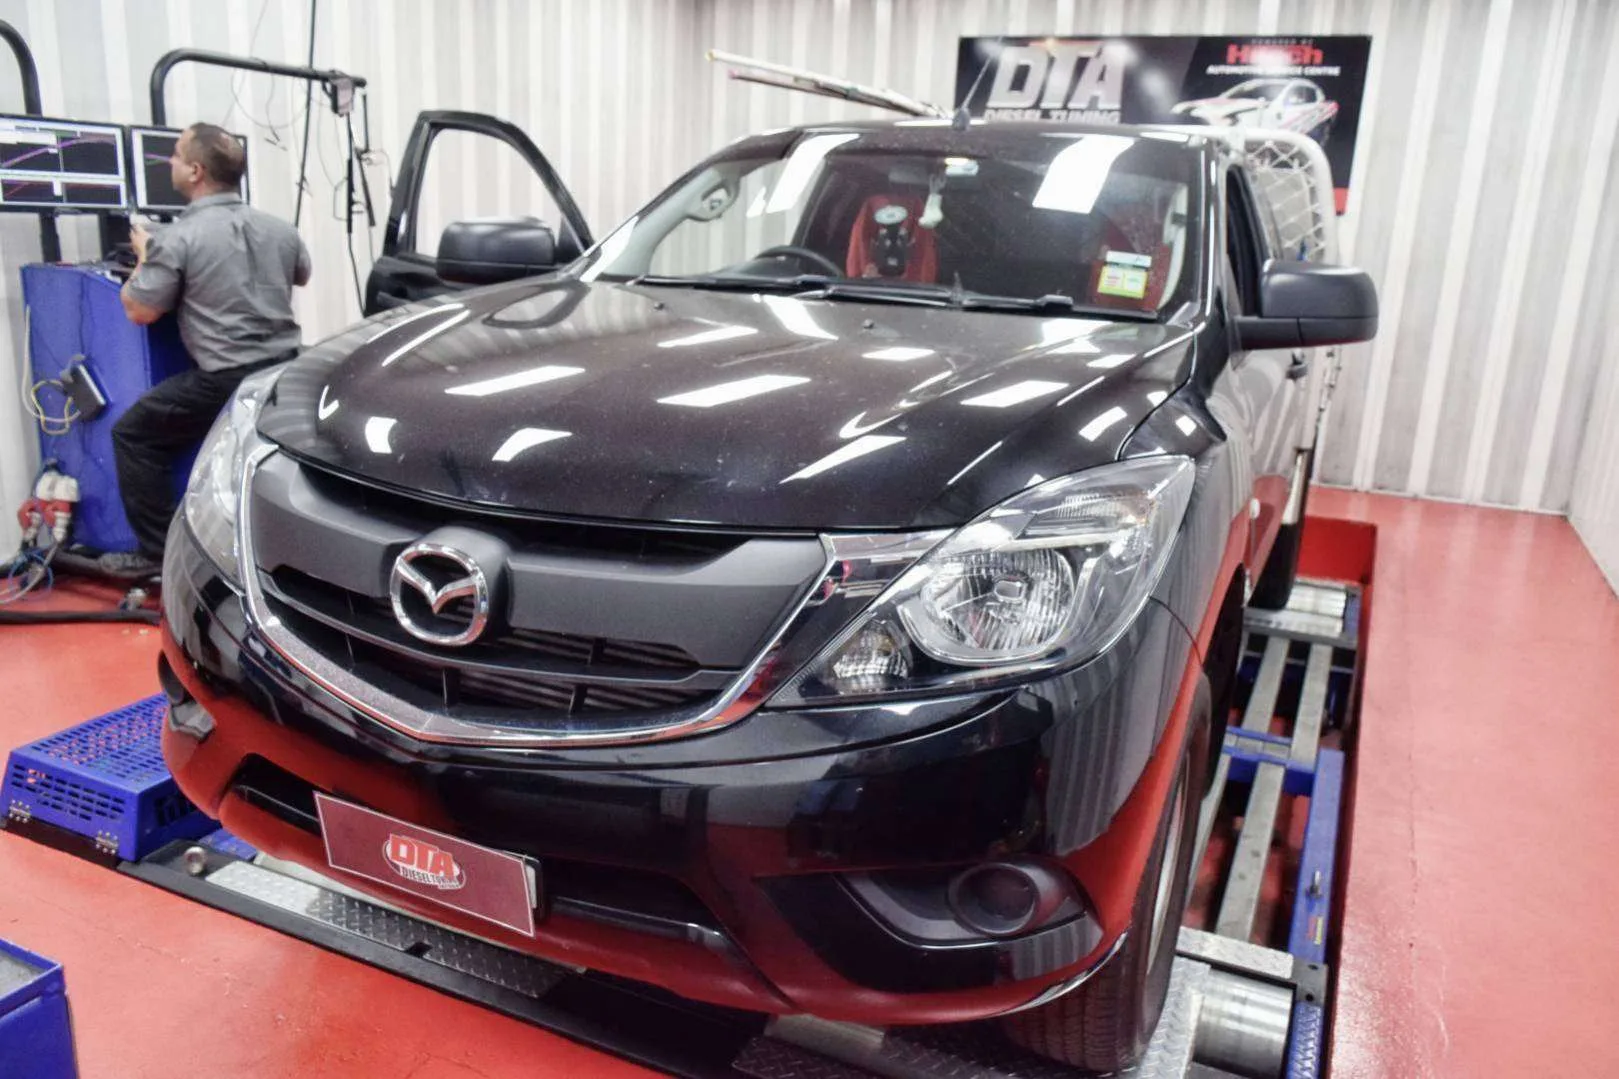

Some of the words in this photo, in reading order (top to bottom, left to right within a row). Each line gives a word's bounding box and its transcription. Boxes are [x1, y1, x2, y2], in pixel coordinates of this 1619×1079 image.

[986, 43, 1121, 110] DTA
[390, 834, 455, 880] DTA
[401, 866, 431, 884] DIESEL
